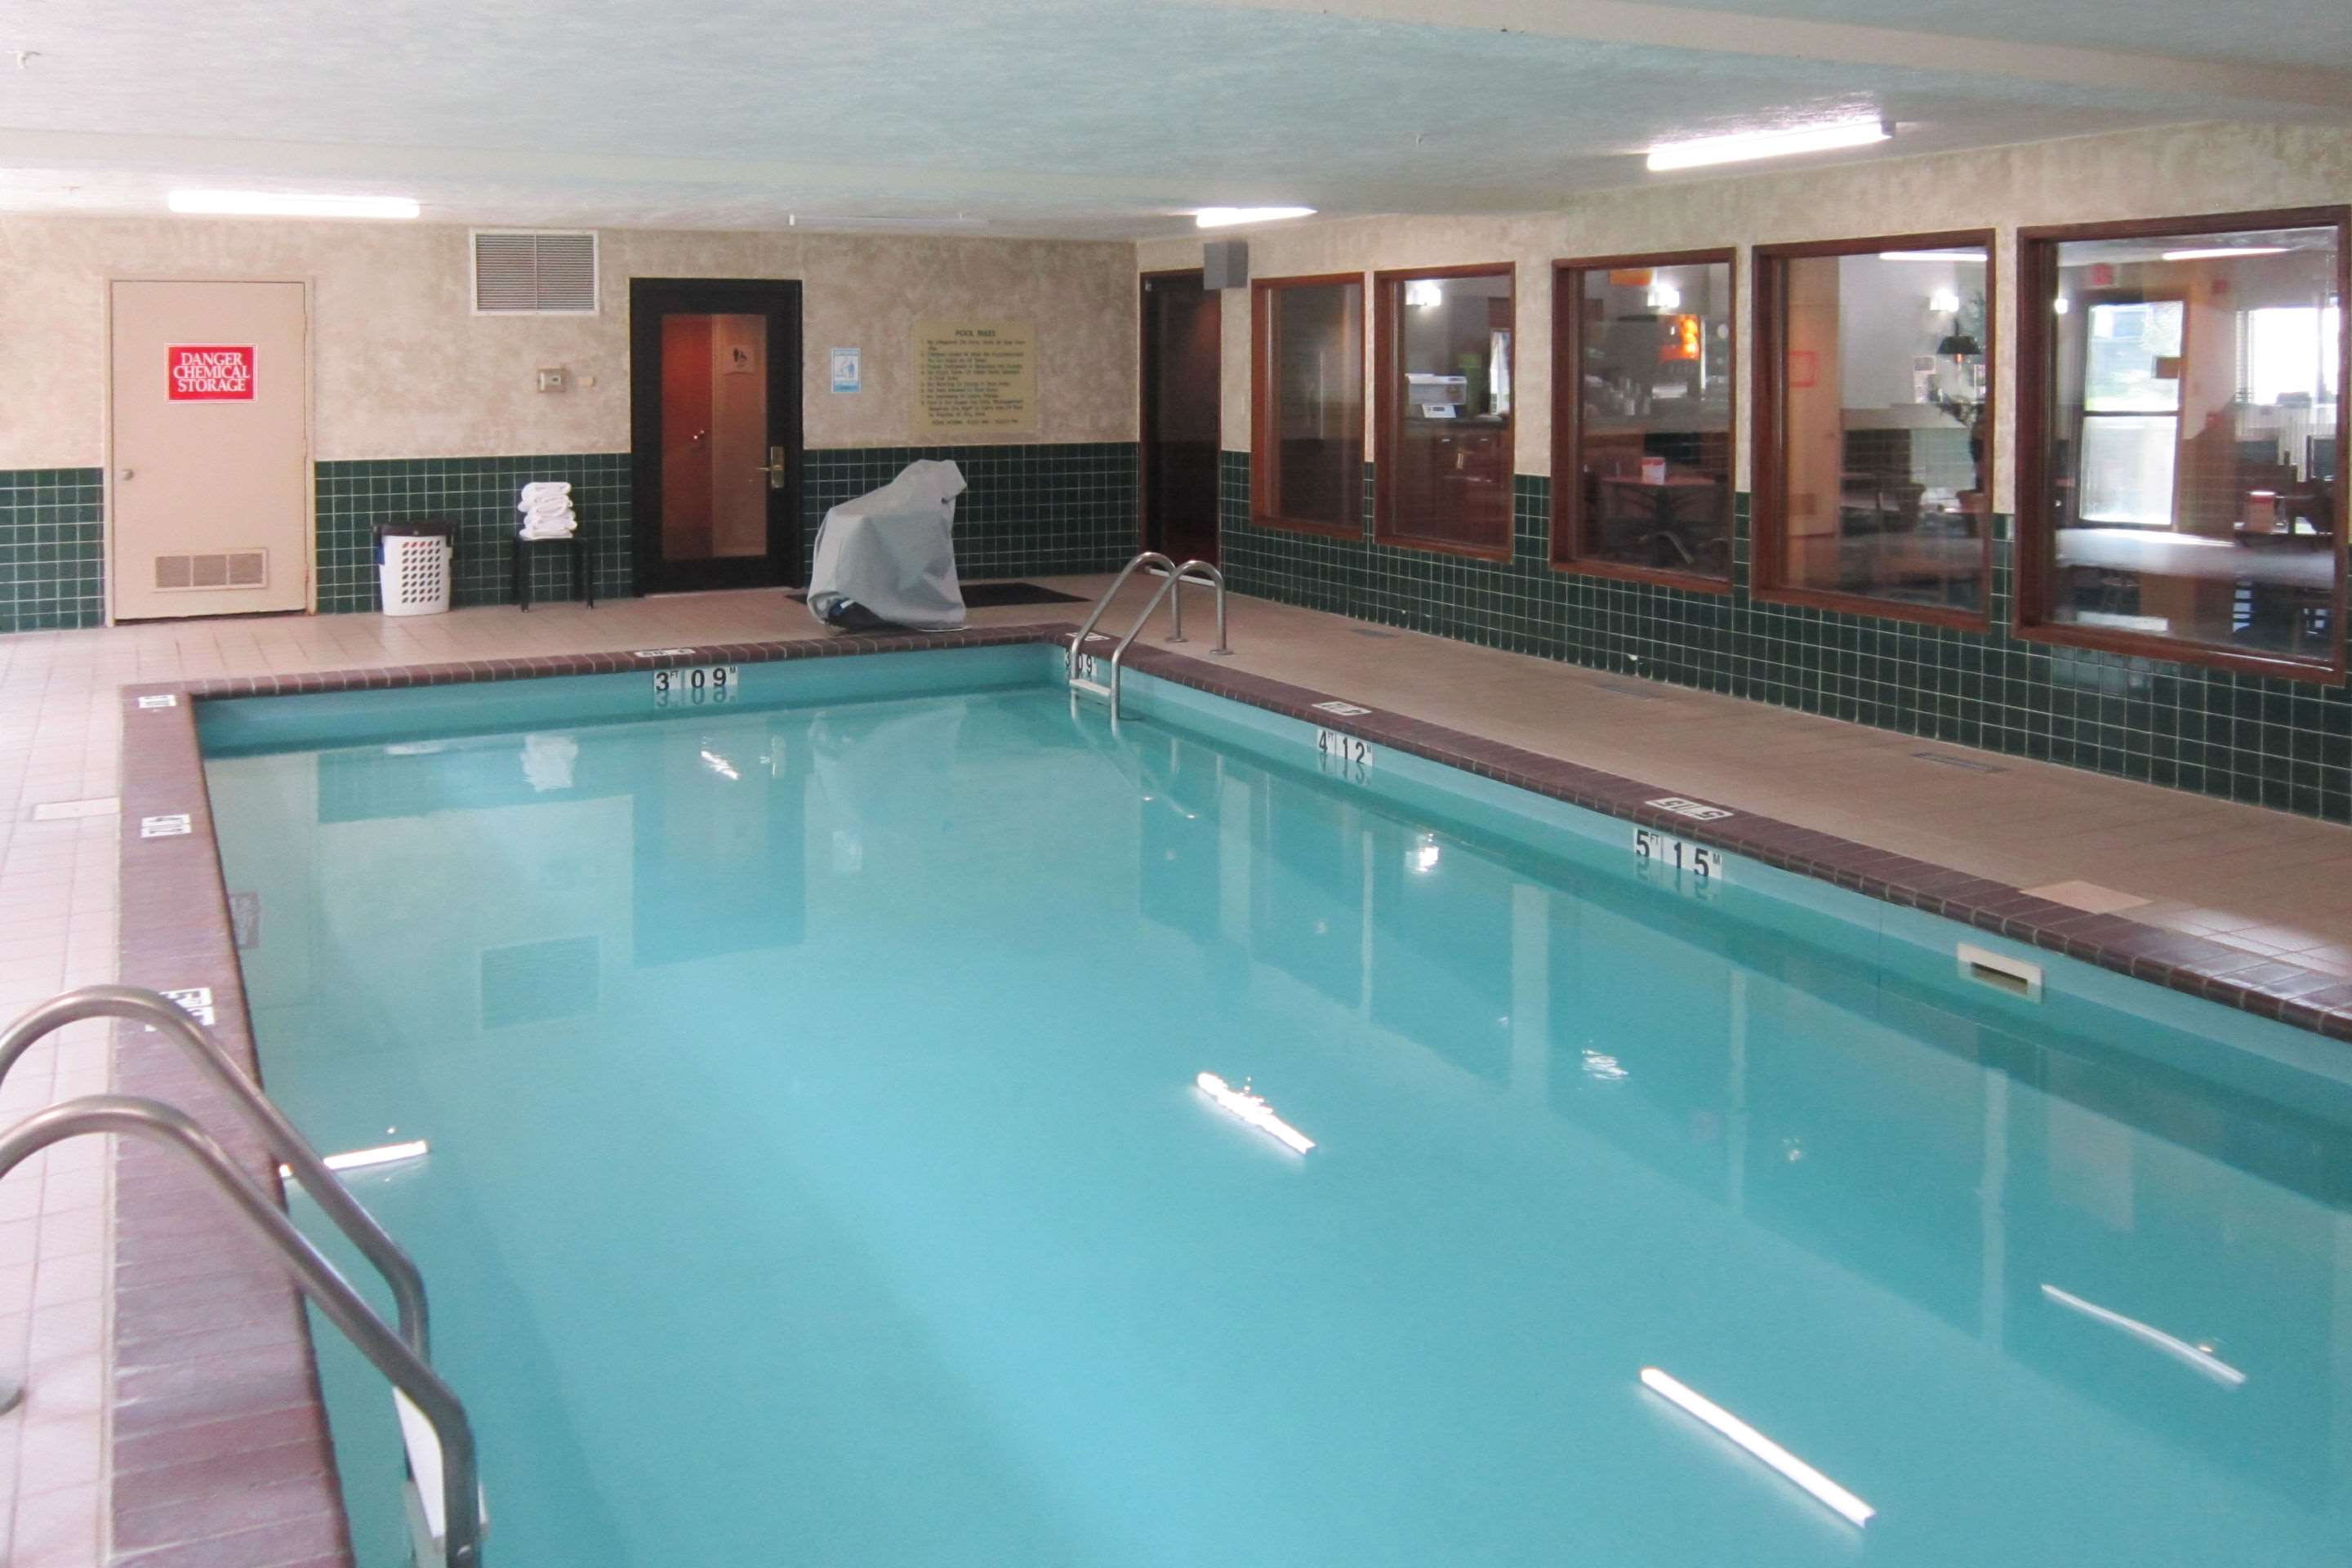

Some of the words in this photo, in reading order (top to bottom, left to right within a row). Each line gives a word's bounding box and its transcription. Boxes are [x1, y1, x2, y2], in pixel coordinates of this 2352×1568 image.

[181, 352, 242, 365] DANGER
[173, 365, 250, 378] CHEMICAL
[178, 378, 246, 392] STORAGE
